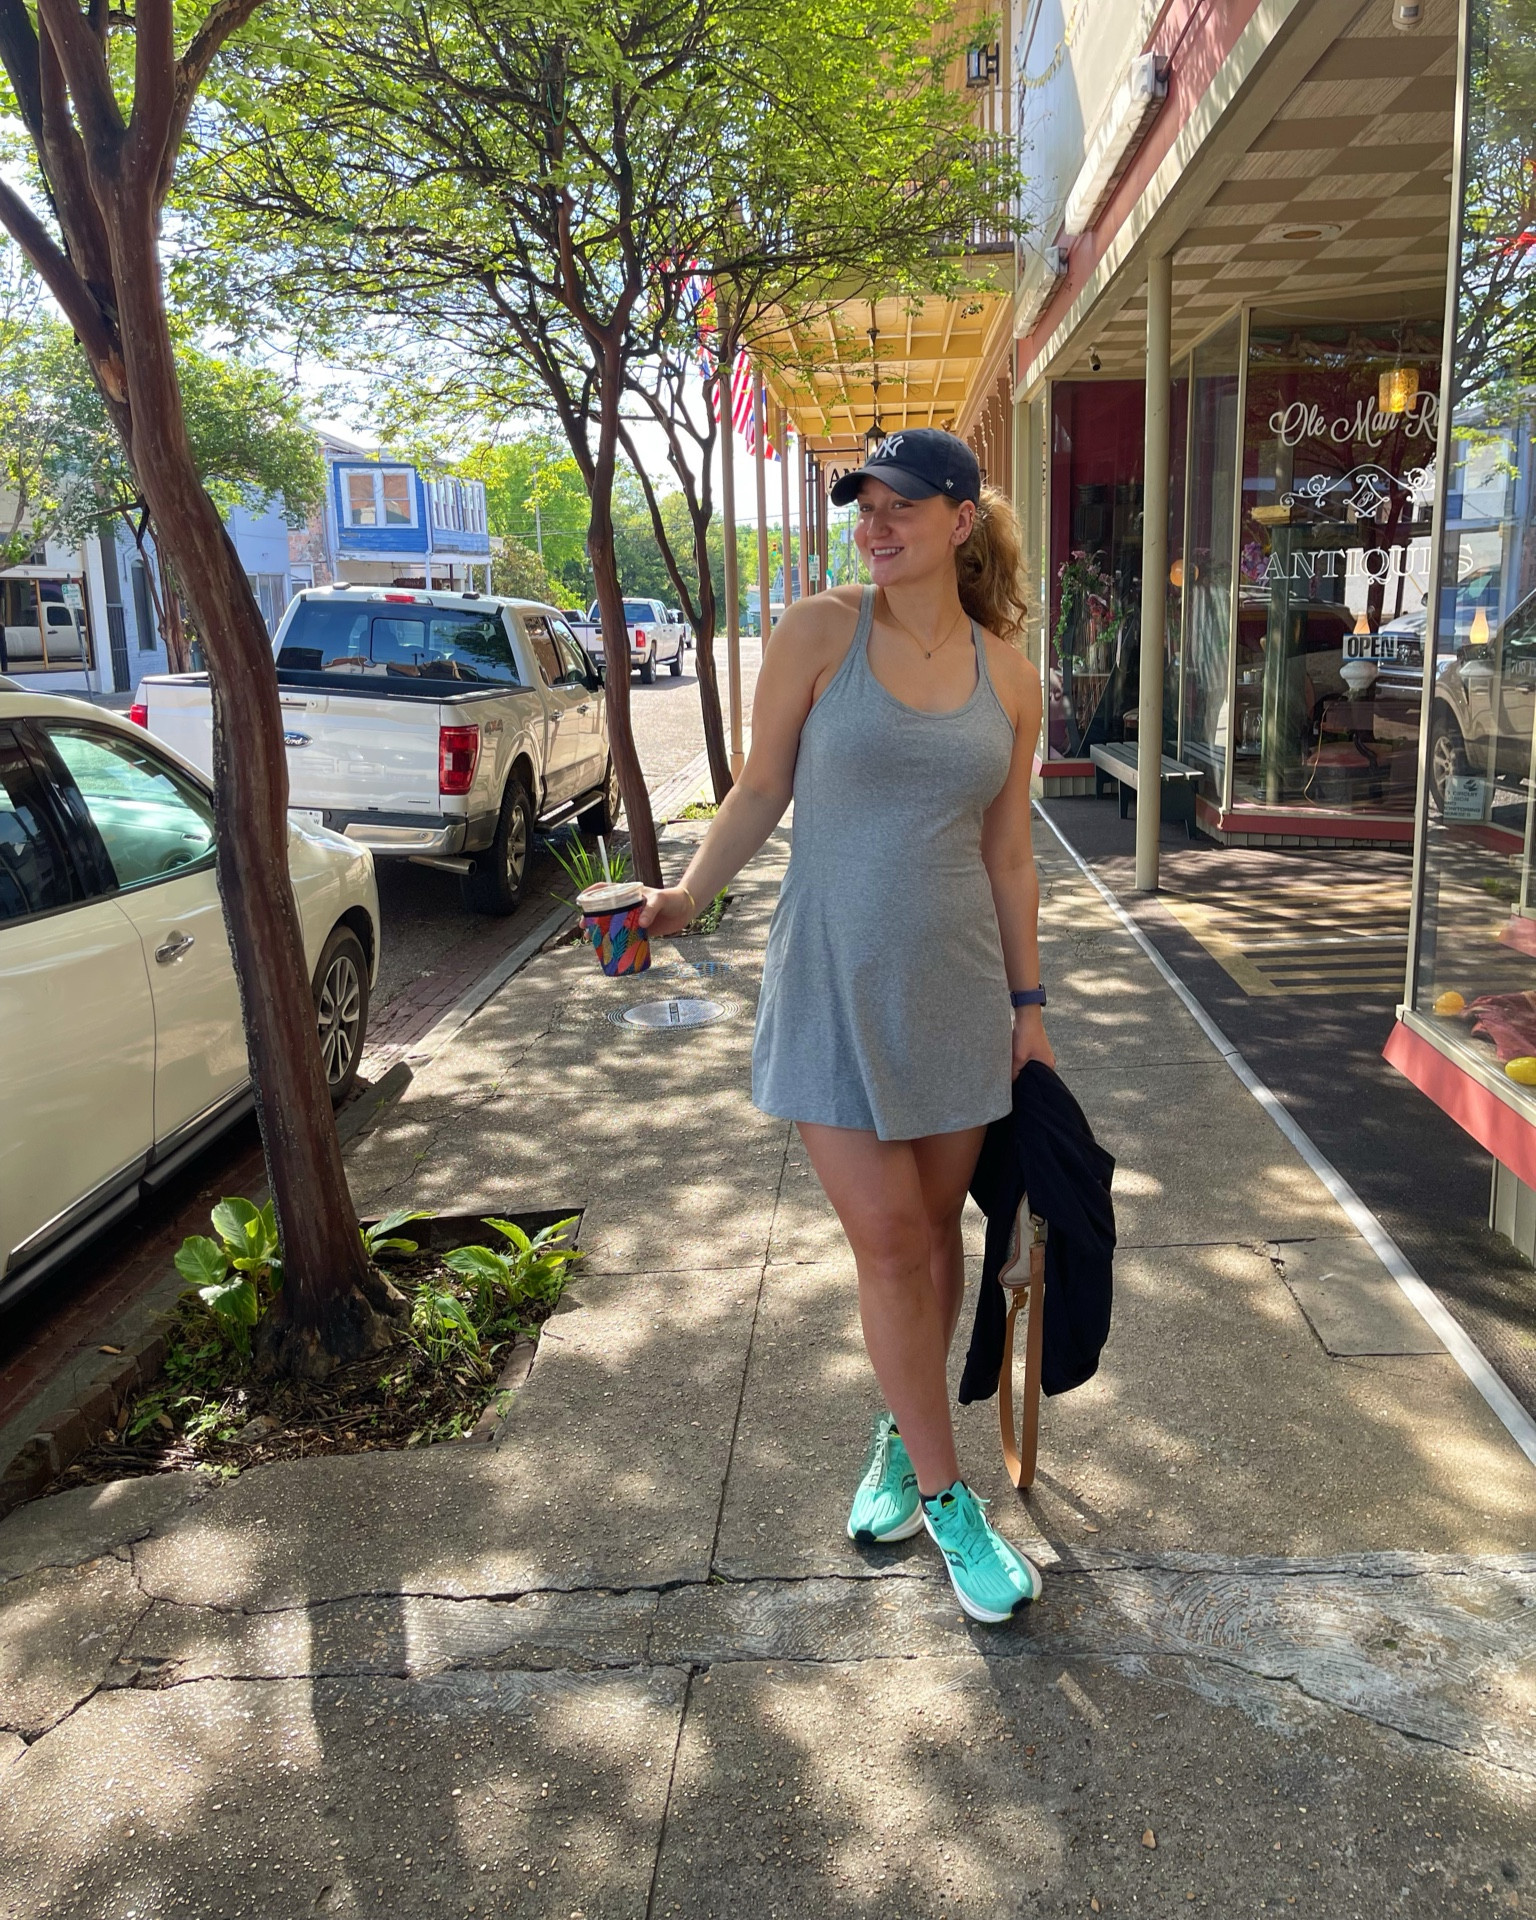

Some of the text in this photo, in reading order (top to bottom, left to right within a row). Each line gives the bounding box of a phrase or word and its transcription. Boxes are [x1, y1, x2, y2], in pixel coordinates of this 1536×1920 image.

[1269, 401, 1327, 446] Ole
[1331, 396, 1399, 447] Man
[1347, 636, 1395, 658] OPEN
